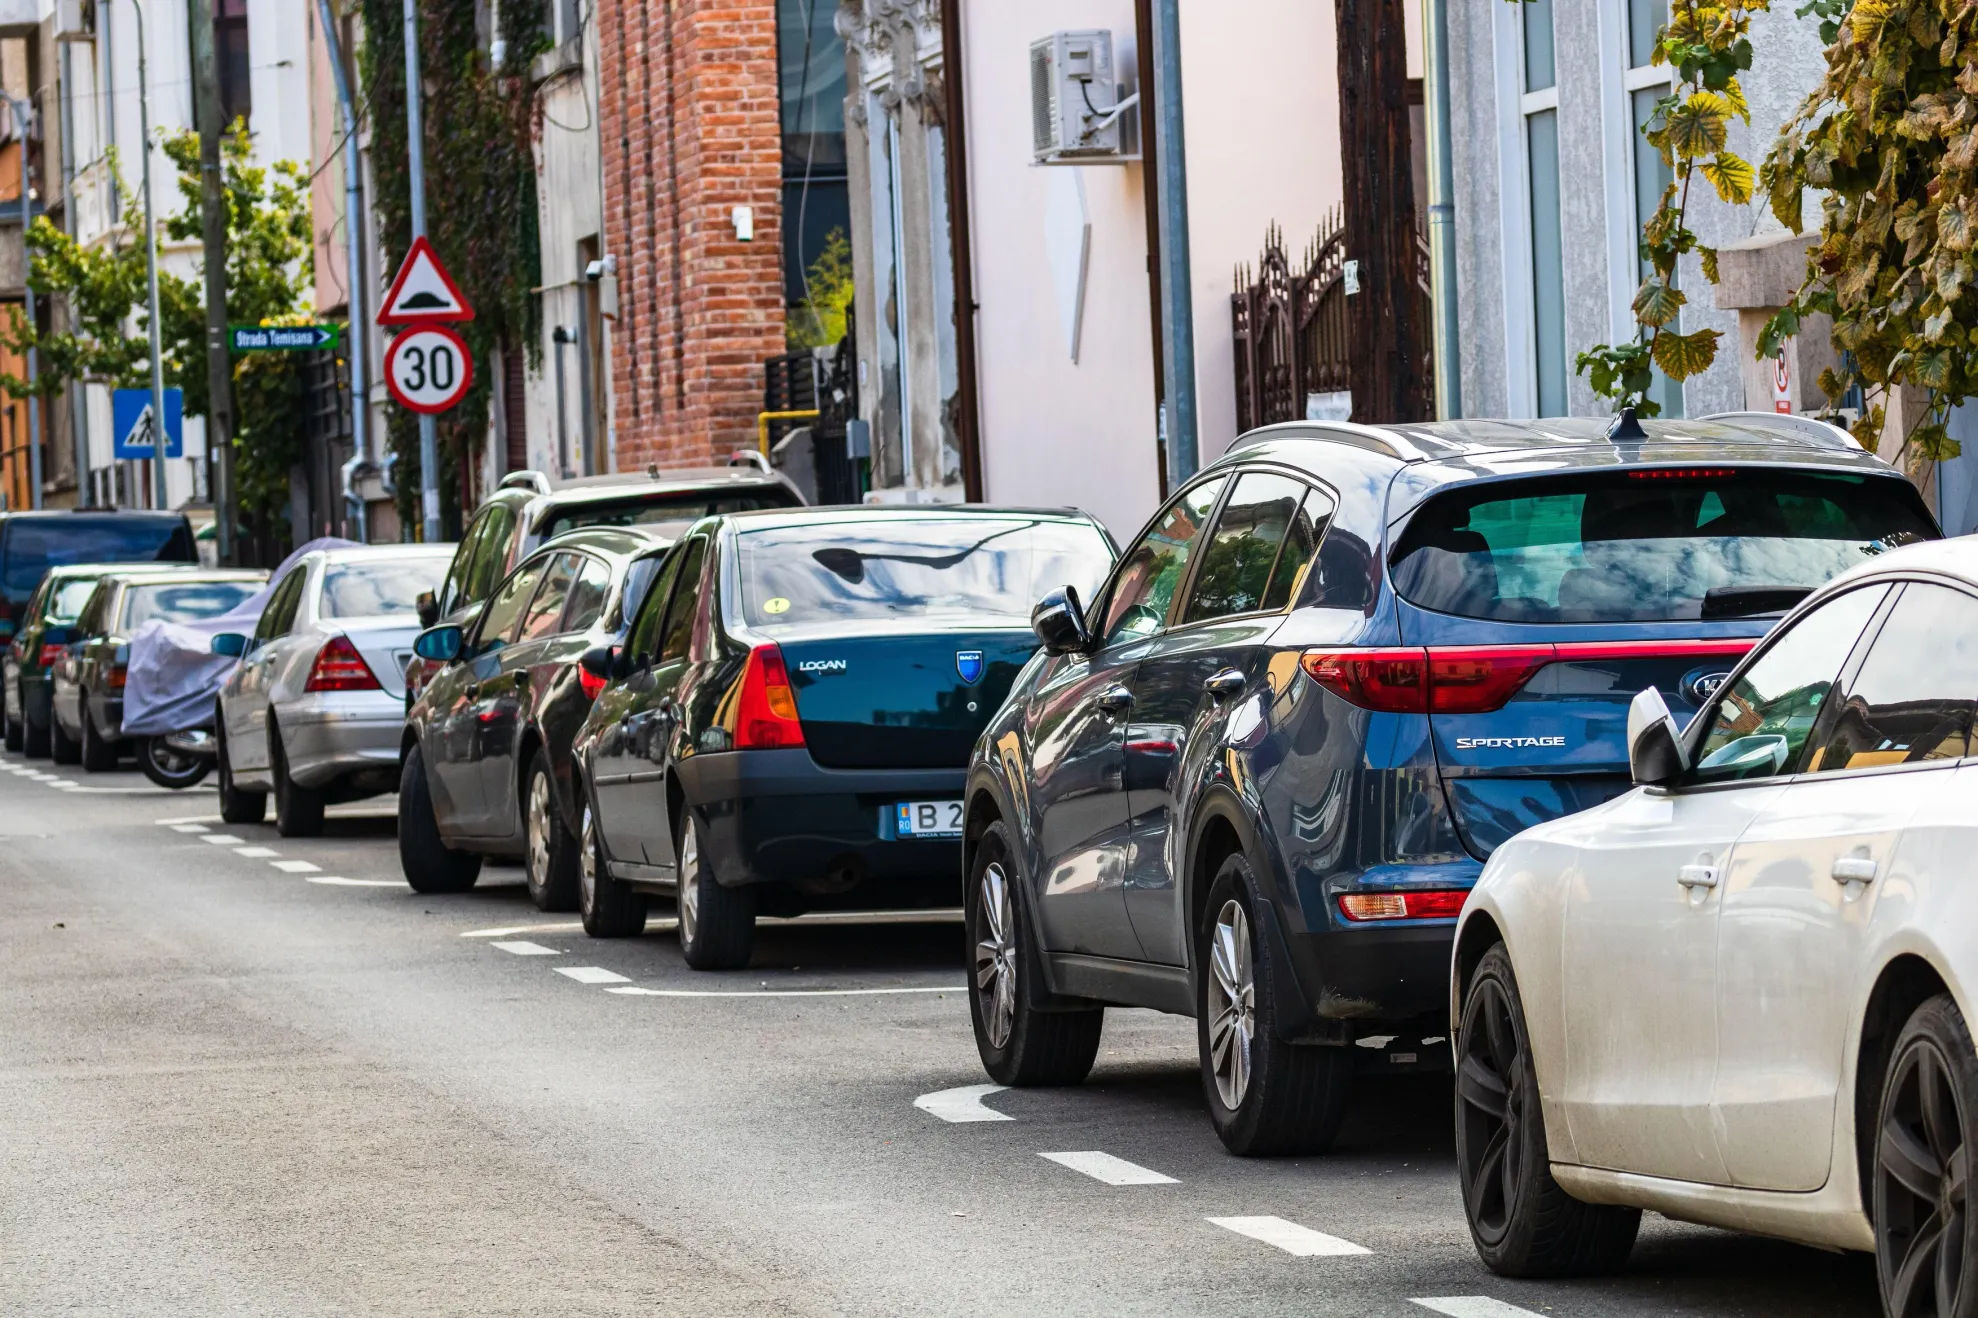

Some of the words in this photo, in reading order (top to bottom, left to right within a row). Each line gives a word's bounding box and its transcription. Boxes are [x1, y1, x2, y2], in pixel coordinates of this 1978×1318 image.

[236, 330, 268, 348] Strada
[403, 345, 454, 391] 30
[799, 660, 847, 671] LOGAN
[1456, 736, 1566, 749] SPORTAGE
[917, 804, 938, 830] B
[898, 820, 911, 831] RO
